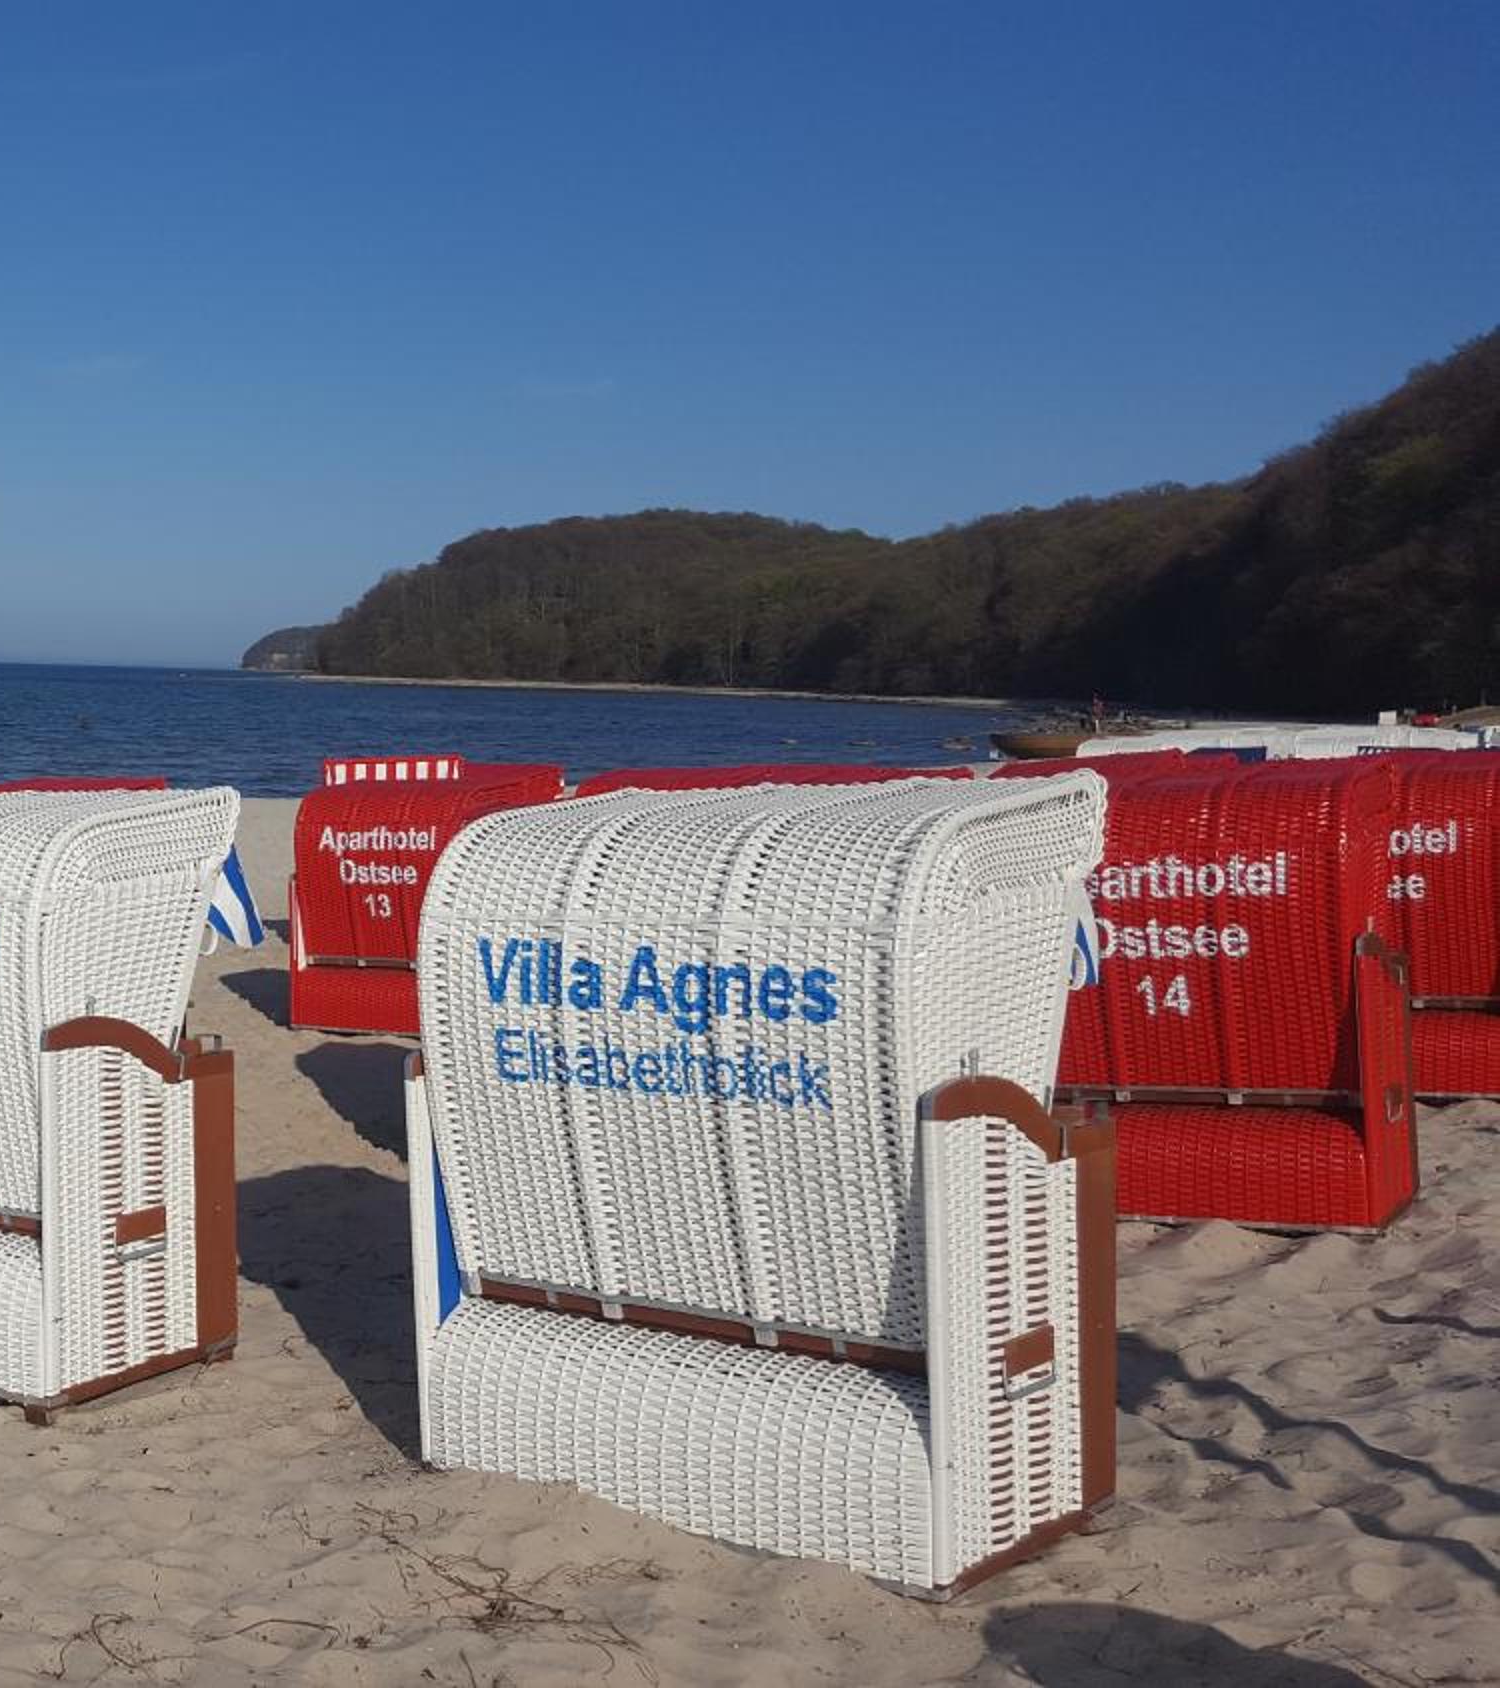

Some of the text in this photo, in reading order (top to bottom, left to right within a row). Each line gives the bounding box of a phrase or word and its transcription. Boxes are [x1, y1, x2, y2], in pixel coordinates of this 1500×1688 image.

[319, 825, 437, 856] Aparthotel
[339, 859, 418, 885] Ostsee
[365, 893, 392, 918] 13
[477, 936, 838, 1035] Villa Agnes
[1137, 973, 1192, 1017] 14
[495, 1027, 833, 1111] Elisabethblick
